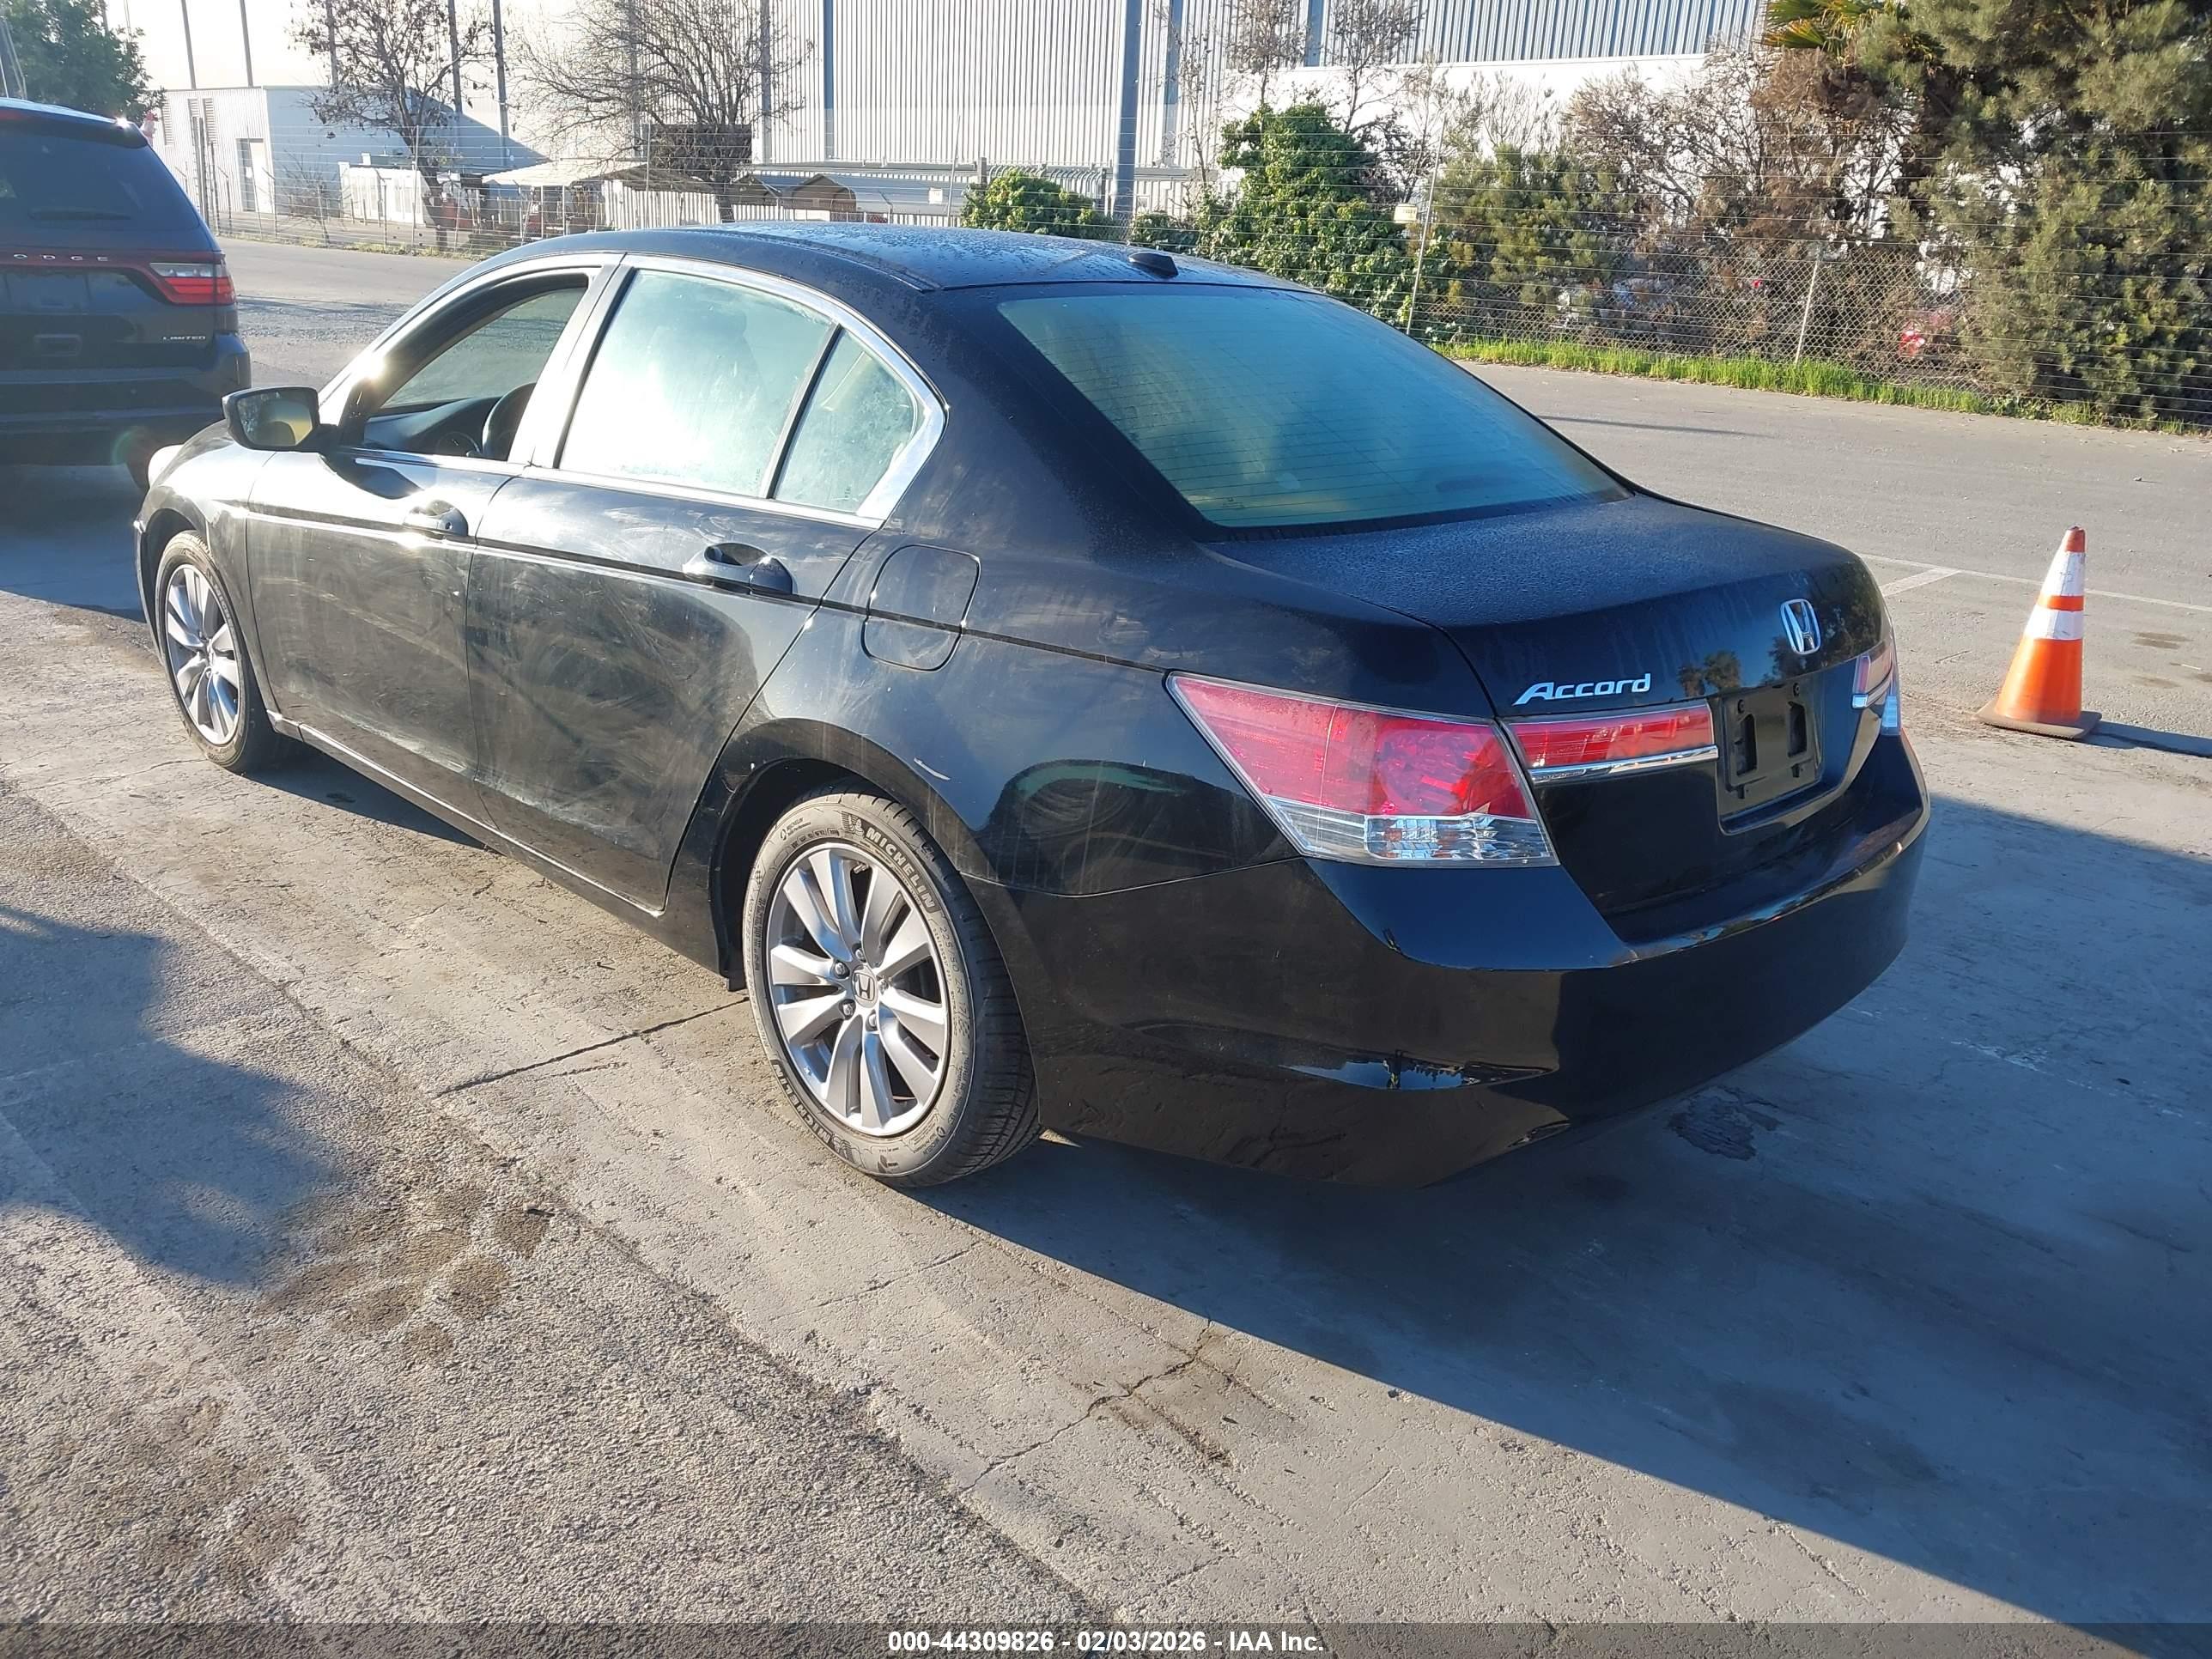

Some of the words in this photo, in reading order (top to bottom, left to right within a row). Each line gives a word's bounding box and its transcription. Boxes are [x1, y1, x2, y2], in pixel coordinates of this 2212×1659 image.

[13, 253, 108, 262] ODGE
[1512, 672, 1651, 707] Accord
[866, 826, 936, 908] MICHELIN
[772, 1064, 831, 1144] MICHELIN
